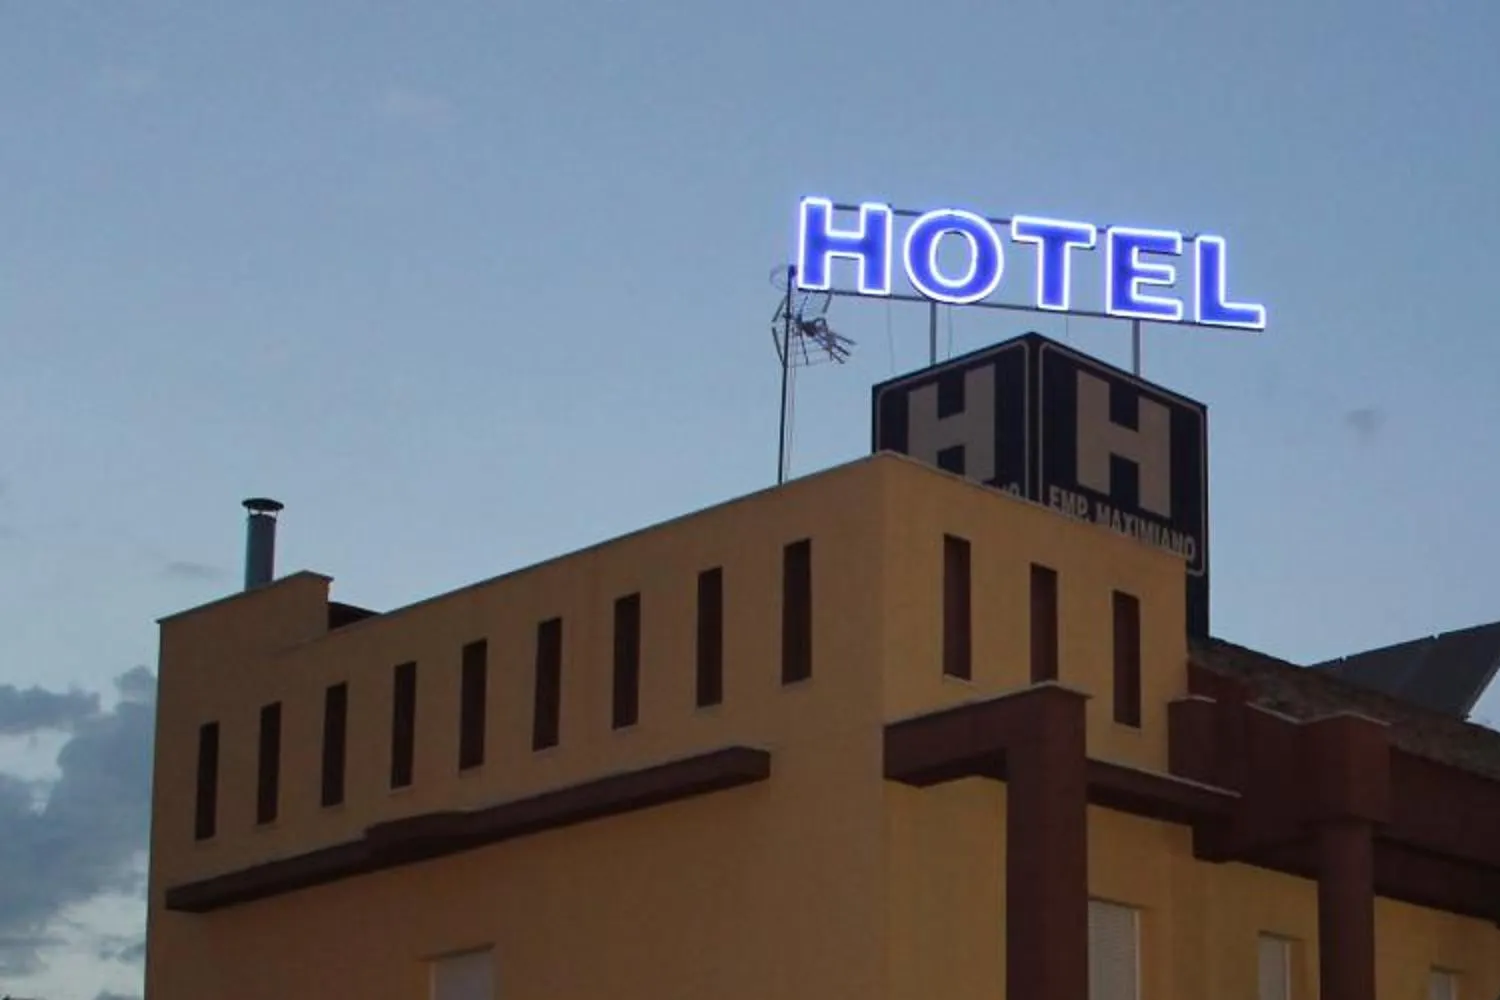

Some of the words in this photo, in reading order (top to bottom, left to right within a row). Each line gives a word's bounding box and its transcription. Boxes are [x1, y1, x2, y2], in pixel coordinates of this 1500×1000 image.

[797, 197, 1266, 330] HOTEL
[1077, 369, 1172, 519] H
[1049, 485, 1091, 523] EMP.
[1094, 501, 1197, 562] MAXIMIANO
